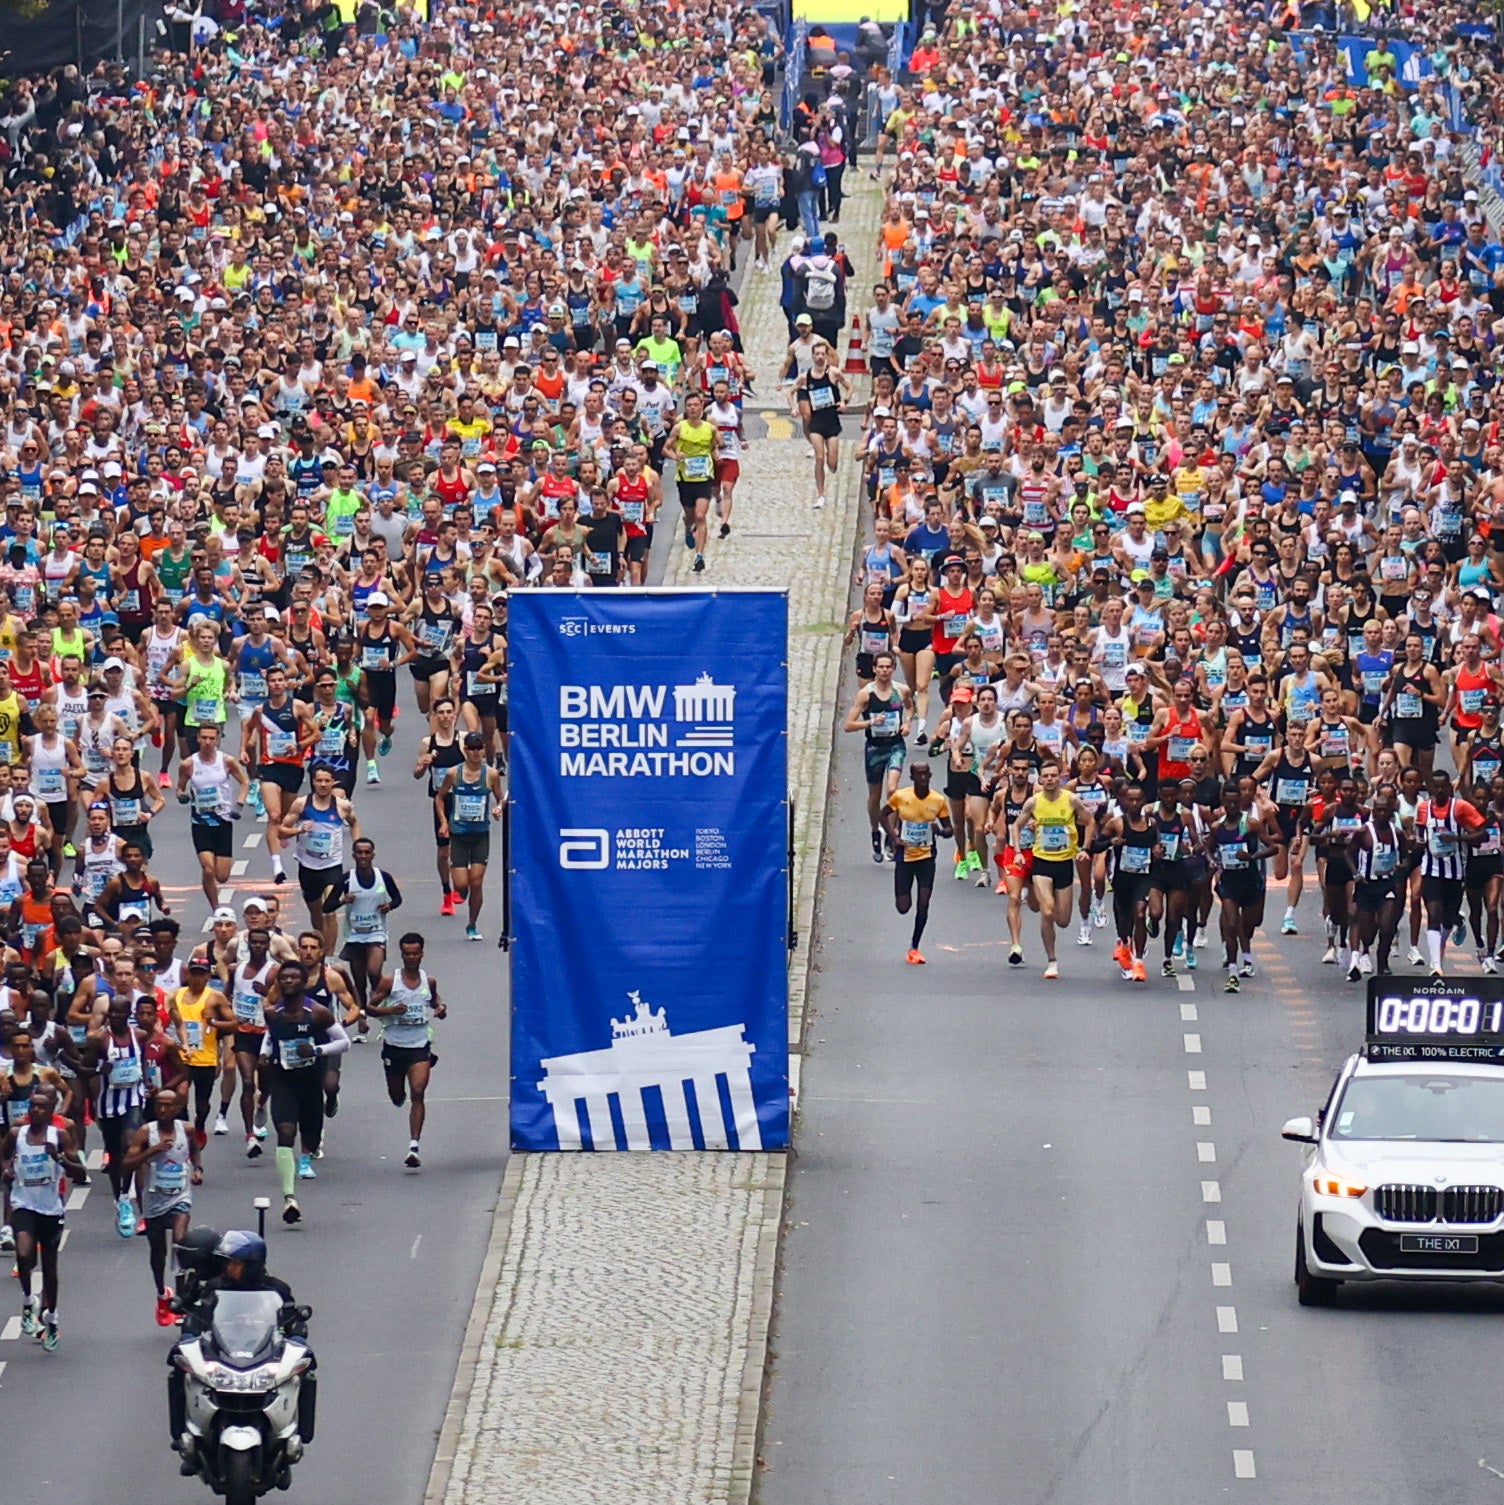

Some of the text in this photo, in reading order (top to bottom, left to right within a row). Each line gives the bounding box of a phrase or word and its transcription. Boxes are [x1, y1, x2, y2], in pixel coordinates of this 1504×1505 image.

[590, 624, 636, 634] EVENTS
[559, 685, 667, 719] BMW
[560, 724, 668, 748] BERLIN
[560, 751, 735, 777] MARATHON
[615, 828, 665, 839] ABBOTT
[616, 839, 661, 849] WORLD
[616, 849, 690, 859] MARATHON
[616, 859, 669, 870] MAJORS
[1413, 987, 1465, 995] NORQAIN
[1379, 998, 1503, 1034] 0:00:01
[1382, 1046, 1402, 1056] THE
[1421, 1047, 1447, 1056] 100%
[1417, 1237, 1460, 1250] THE iX1
